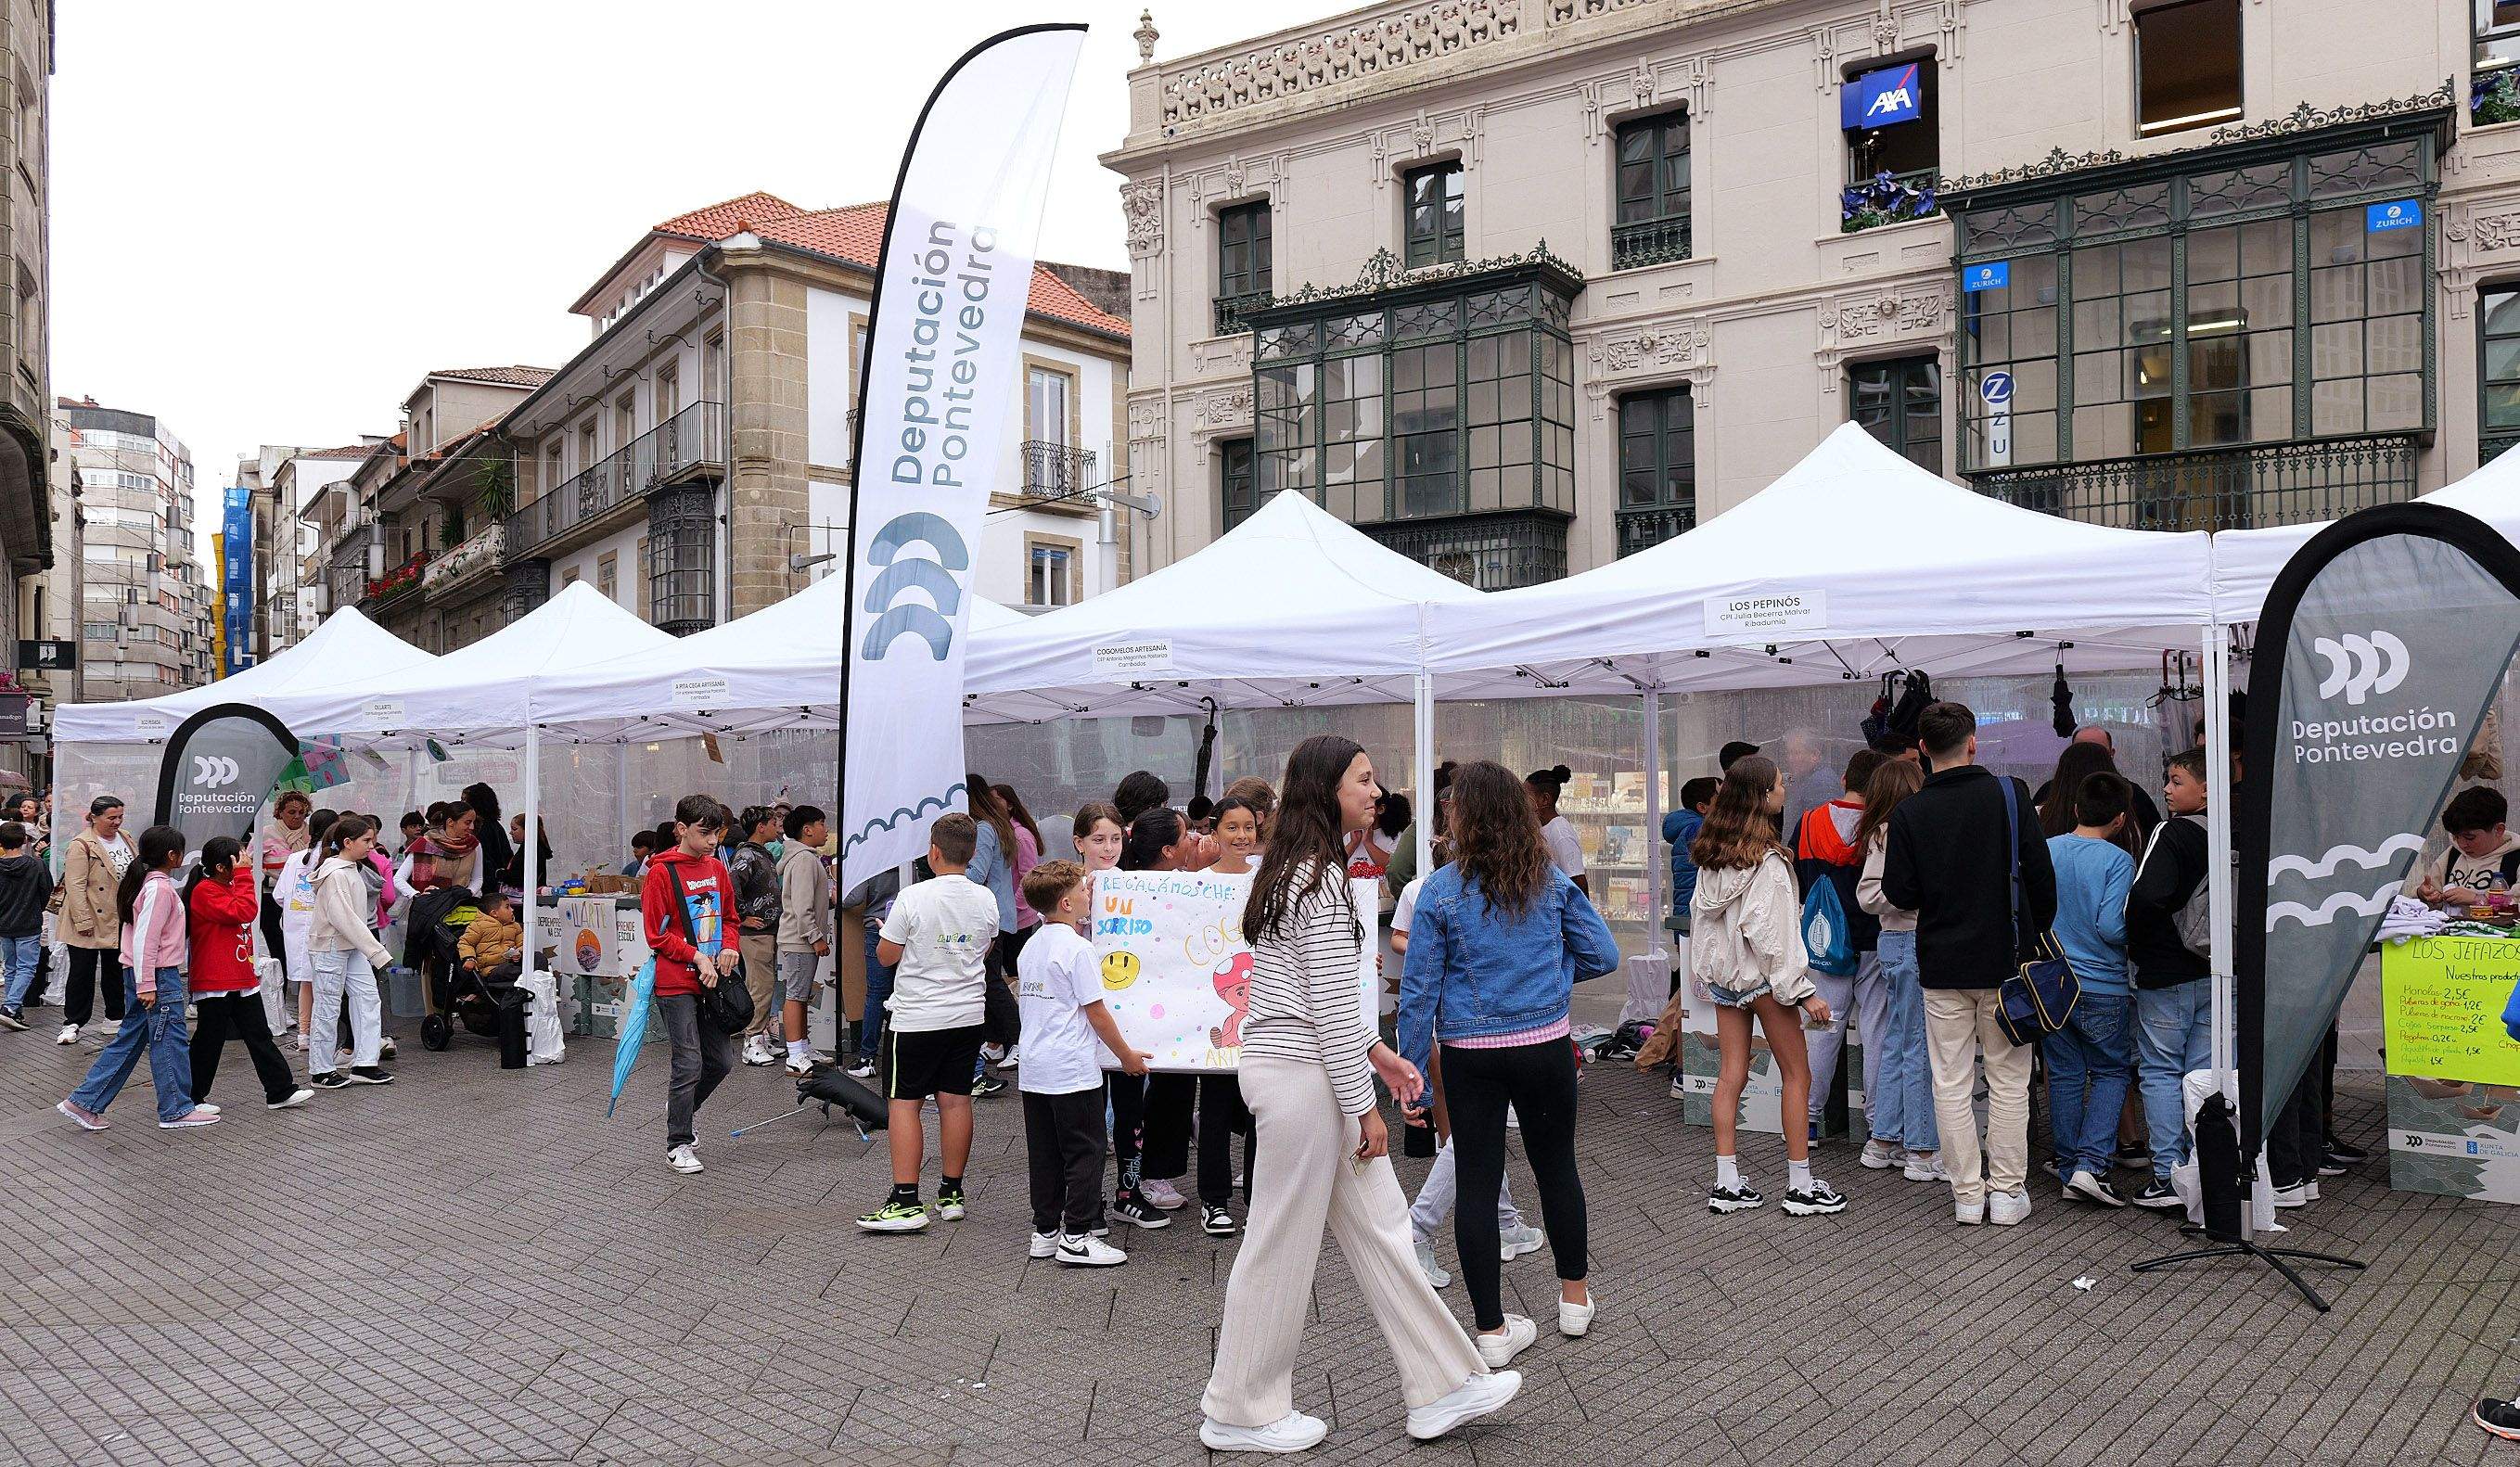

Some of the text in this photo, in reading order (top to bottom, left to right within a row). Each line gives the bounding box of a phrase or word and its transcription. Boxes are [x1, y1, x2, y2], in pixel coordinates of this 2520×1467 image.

[1866, 87, 1912, 117] AXA
[2375, 217, 2412, 228] ZURICH
[1972, 278, 2002, 288] ZURICH
[891, 221, 956, 485] Deputación
[932, 225, 997, 488] Pontevedra
[1730, 595, 1801, 612] LOS PEPINÓS
[1733, 612, 1752, 620] Julia
[1753, 610, 1783, 619] Becerra
[1745, 619, 1786, 628] Ribadumia
[1096, 643, 1168, 656] COGOMELOS ARTESANÍA
[2292, 706, 2456, 745] Deputación
[2294, 735, 2458, 763] Pontevedra
[179, 791, 256, 805] Deputación
[1105, 895, 1133, 915] UN
[937, 932, 973, 943] LUCAS
[2412, 940, 2445, 960] LOS
[2479, 1142, 2504, 1151] XUNTA
[2490, 1150, 2519, 1158] GALICIA
